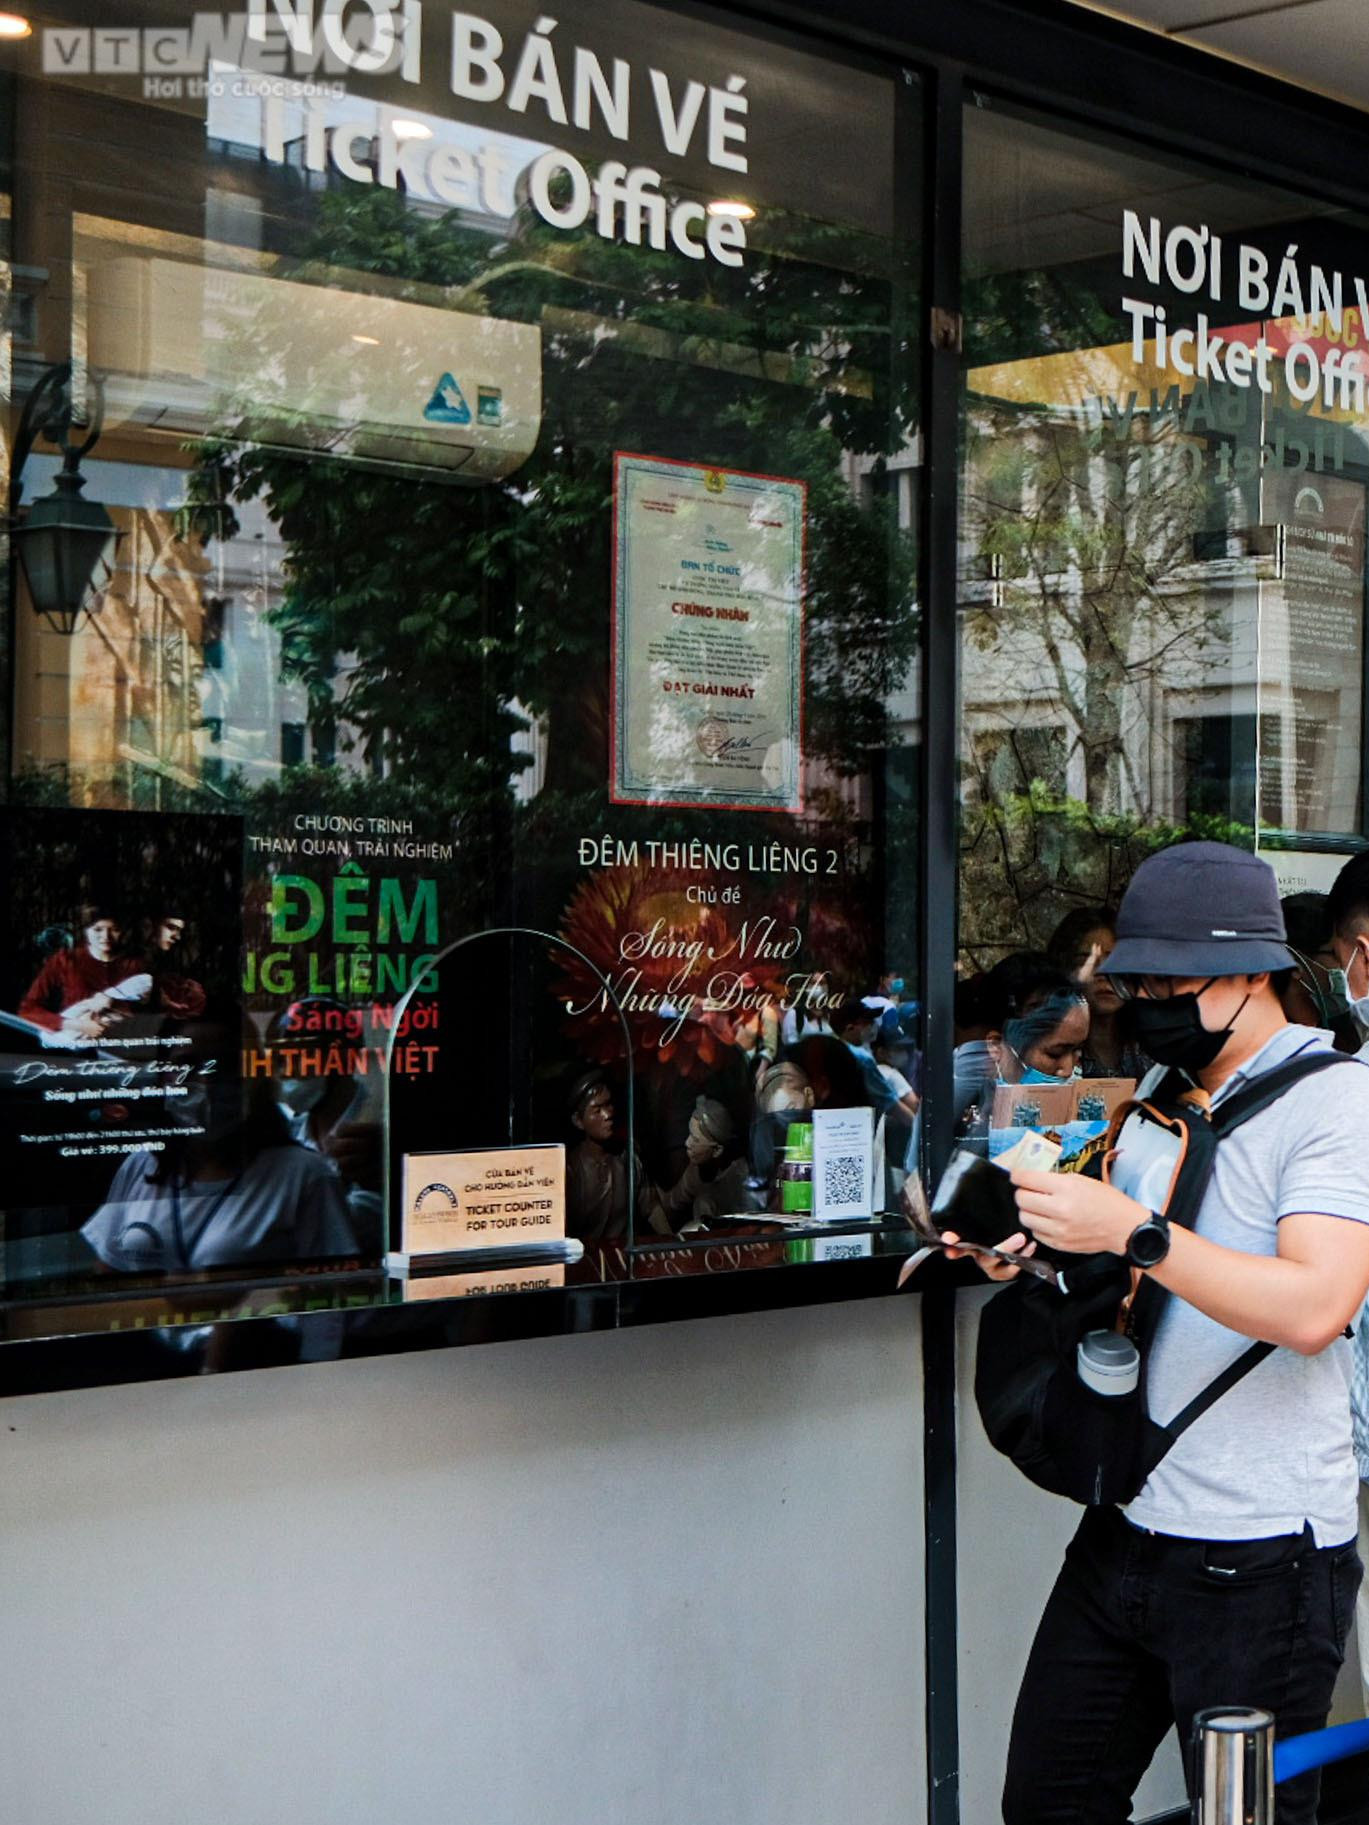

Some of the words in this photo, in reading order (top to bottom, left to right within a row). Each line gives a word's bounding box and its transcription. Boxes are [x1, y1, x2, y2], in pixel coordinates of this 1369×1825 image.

[451, 16, 631, 141] BÁN
[650, 74, 749, 174] VÉ
[255, 90, 518, 219] Ticket
[529, 149, 748, 268] Office
[1122, 209, 1222, 302] NƠI
[1239, 244, 1343, 334] BÁN
[1122, 297, 1273, 394] Ticket
[721, 682, 756, 700] NHẤT
[294, 814, 364, 834] CHƯƠNG
[367, 816, 413, 835] TRÌNH
[249, 836, 298, 855] THAM
[356, 838, 389, 857] TRẢI
[393, 841, 453, 859] NGHIỆM
[577, 834, 639, 867] ĐÊM
[645, 838, 740, 871] THIÊNG
[748, 840, 818, 874] LIÊNG
[825, 849, 838, 875] 2
[266, 861, 439, 945] ĐÊM
[686, 884, 718, 904] Chủ
[309, 943, 439, 994] LIÊNG
[618, 916, 704, 995] Sống
[706, 915, 803, 961] Như
[286, 1000, 364, 1037] Sáng
[371, 1000, 439, 1037] Ngời
[566, 966, 697, 1048] Những
[779, 970, 845, 1011] Hoa
[198, 1059, 218, 1075] 2
[374, 1040, 440, 1082] VIỆT
[99, 1144, 142, 1155] 399.000
[465, 1183, 482, 1193] CHO
[465, 1203, 502, 1216] TICKET
[504, 1200, 553, 1213] COUNTER
[466, 1219, 487, 1231] FOR
[490, 1218, 518, 1230] TOUR
[521, 1215, 552, 1227] GUIDE
